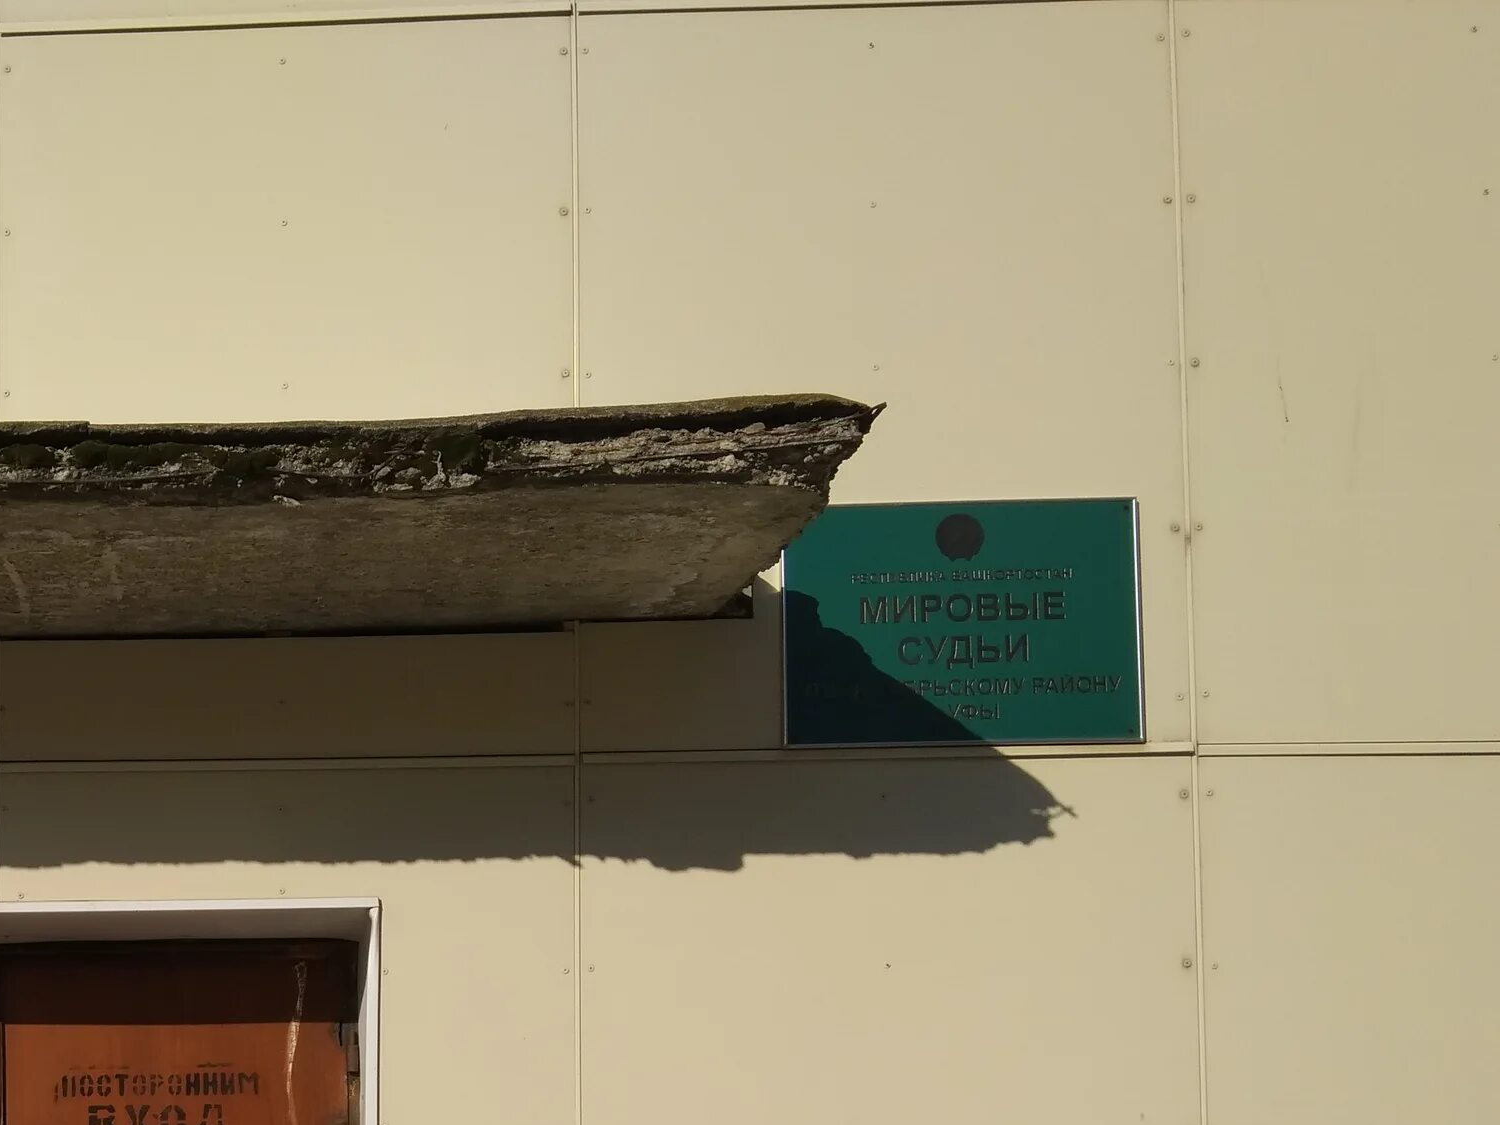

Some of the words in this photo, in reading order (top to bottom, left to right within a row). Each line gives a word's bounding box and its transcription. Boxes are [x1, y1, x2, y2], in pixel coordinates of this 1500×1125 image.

[851, 571, 946, 584] РЕСПБЛИКА
[860, 591, 1067, 625] МИРОВЫЕ
[899, 634, 1030, 669] СУДЬИ
[1033, 673, 1122, 695] РАЙОНУ
[948, 703, 1000, 720] УФЫ
[61, 1072, 260, 1097] ПОСТОРОННИМ
